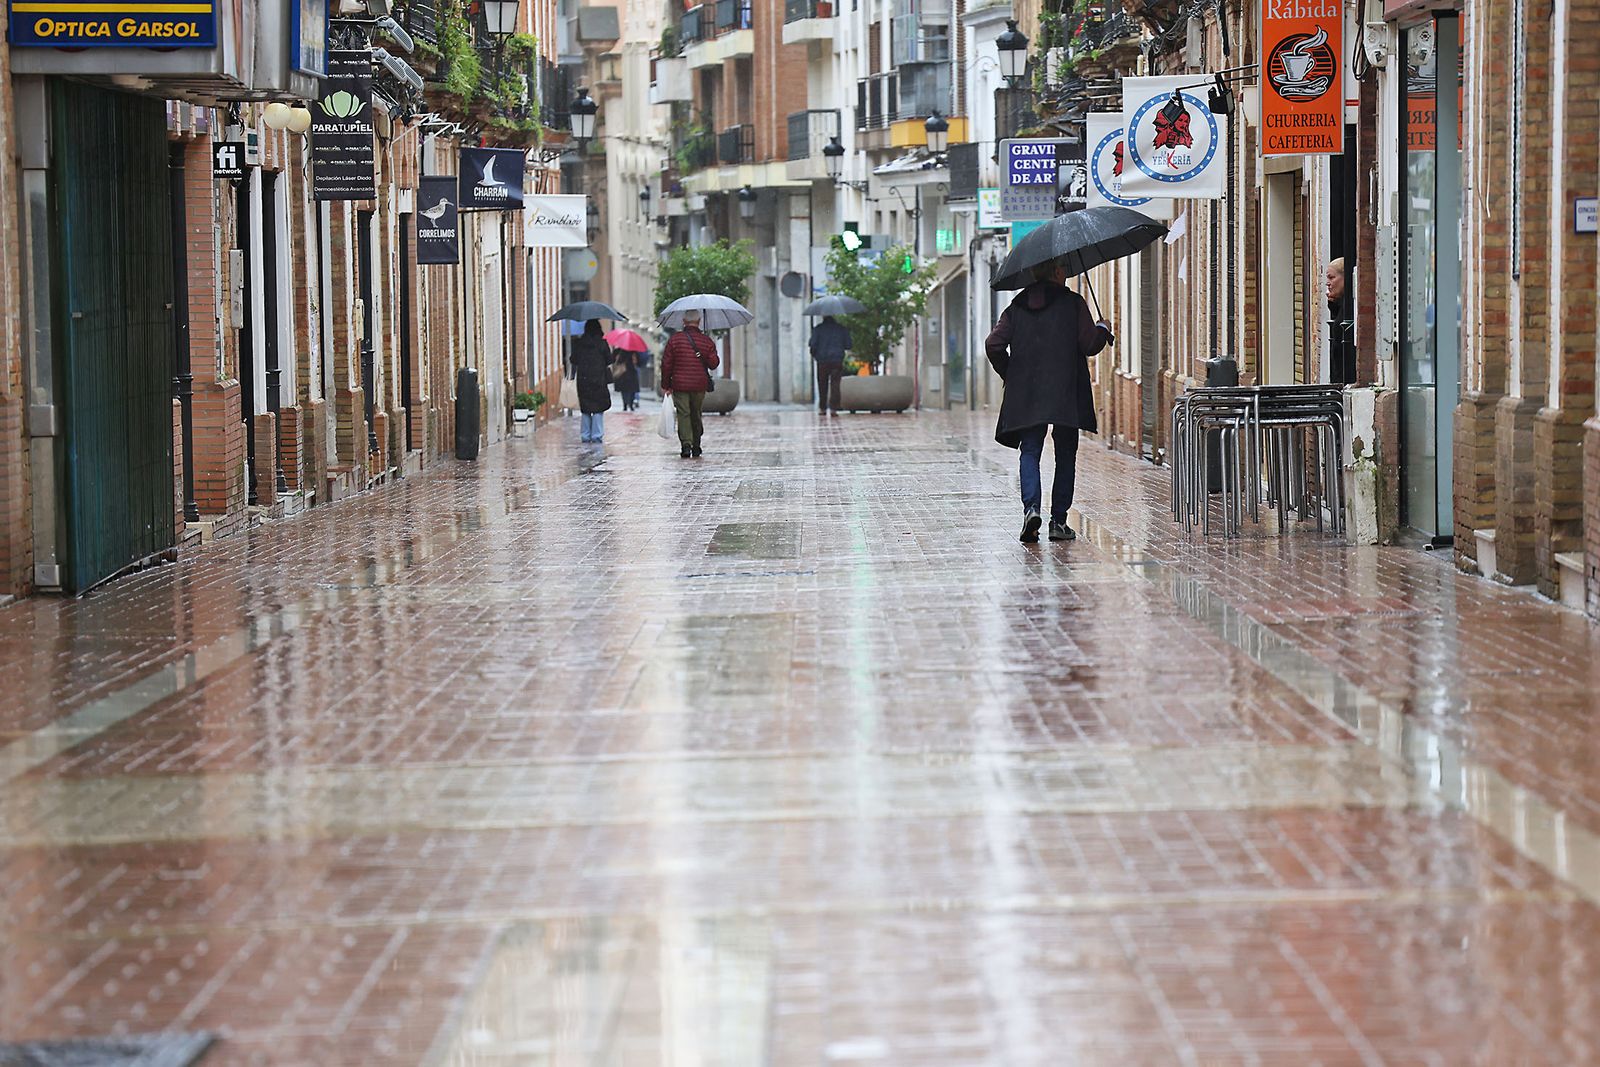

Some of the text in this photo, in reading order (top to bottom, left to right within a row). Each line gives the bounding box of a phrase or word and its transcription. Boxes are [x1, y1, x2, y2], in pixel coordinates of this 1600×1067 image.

[1266, 0, 1337, 19] Rábida
[34, 17, 200, 37] OPTICA GARSOL
[312, 123, 372, 132] PARATUPIEL
[1266, 113, 1337, 128] CHURRERIA
[1269, 134, 1334, 149] CAFETERIA
[216, 145, 237, 169] fi
[1012, 173, 1031, 184] DE
[473, 186, 508, 198] CHARRÁN
[418, 228, 456, 238] CORRELIMOS
